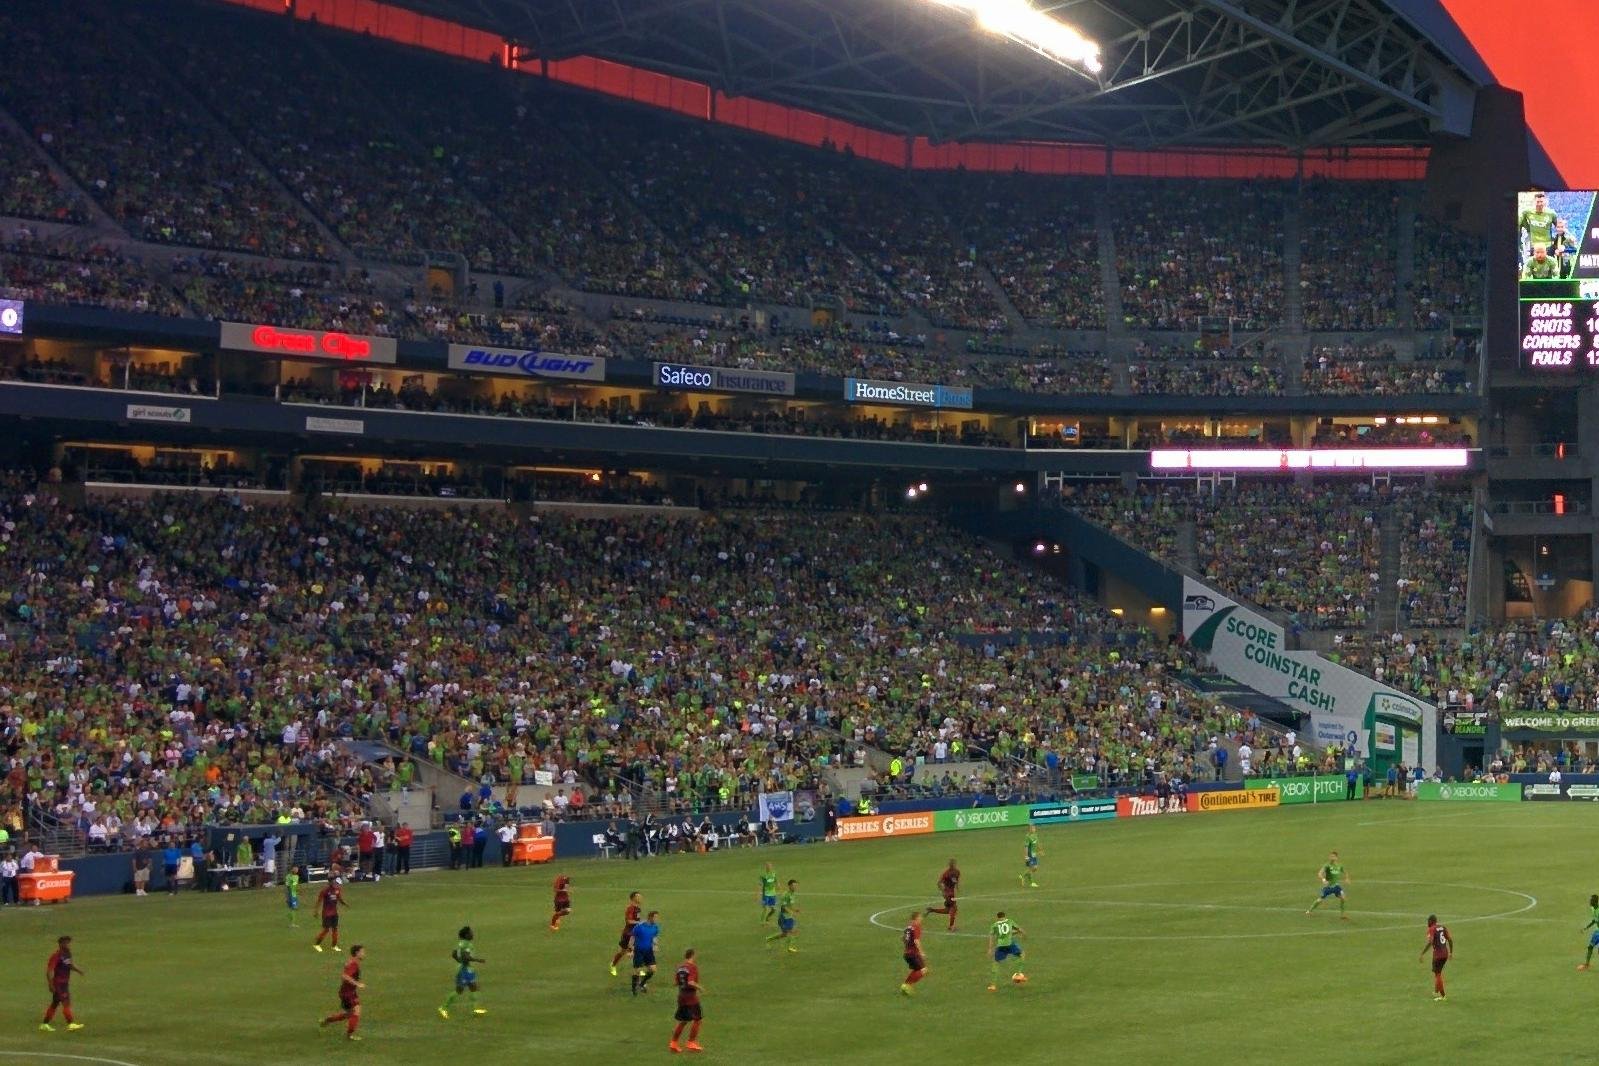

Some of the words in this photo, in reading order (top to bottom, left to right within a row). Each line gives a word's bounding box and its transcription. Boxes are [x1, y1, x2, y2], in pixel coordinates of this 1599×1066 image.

[1530, 303, 1573, 317] GOALS
[1530, 319, 1573, 333] SHOTS
[1522, 334, 1581, 349] CORNERS
[464, 351, 518, 367] BUD
[527, 356, 594, 374] LIGHT
[1531, 350, 1573, 365] FOULS
[660, 366, 712, 387] Safeco
[717, 371, 786, 391] Insurance
[856, 383, 935, 402] HomeStreet
[1226, 616, 1278, 649] SCORE
[1244, 643, 1321, 687] COINSTAR
[1288, 681, 1336, 713] CASH!
[1505, 716, 1553, 728] WELCOME
[1556, 718, 1570, 728] TO
[1282, 782, 1310, 797] XBOX
[1314, 780, 1343, 794] PITCH
[1452, 787, 1477, 797] XBOX
[1477, 786, 1499, 797] ONE
[1201, 793, 1249, 809] Continental
[1258, 792, 1277, 803] TIRE
[843, 821, 880, 835] SERIES
[894, 817, 929, 830] SERIES
[967, 812, 991, 825] XBOX
[991, 811, 1009, 823] ONE
[997, 923, 1010, 935] 10
